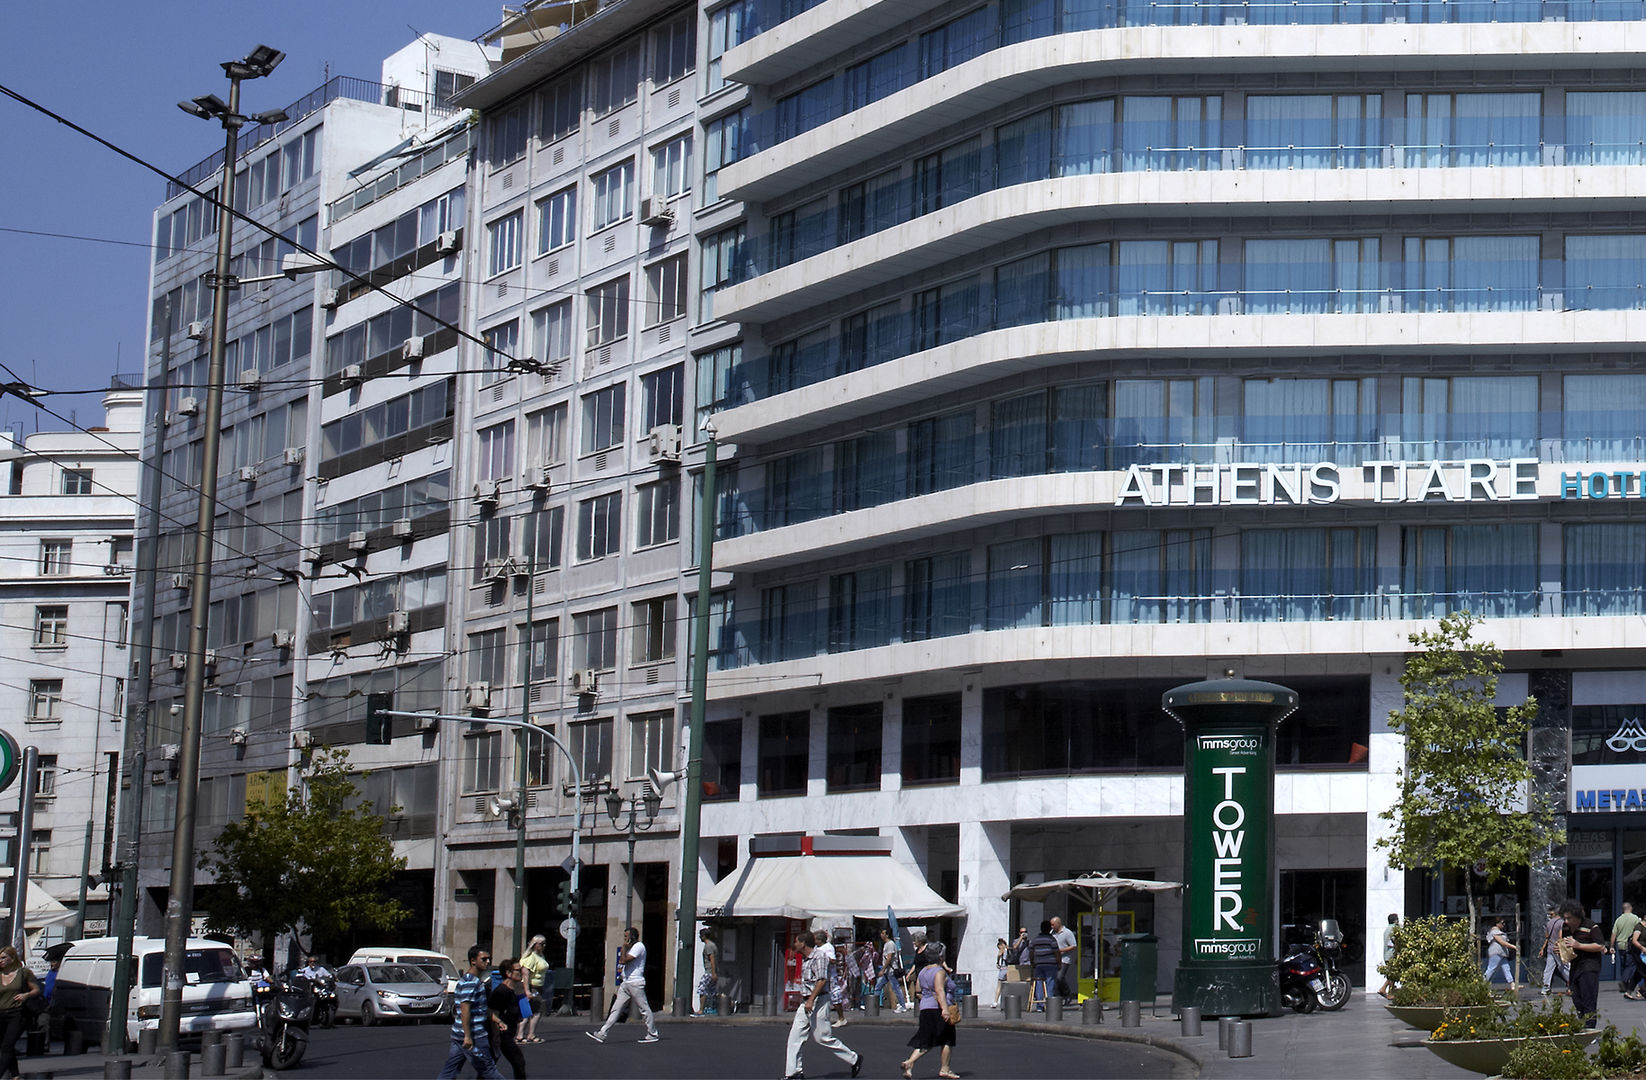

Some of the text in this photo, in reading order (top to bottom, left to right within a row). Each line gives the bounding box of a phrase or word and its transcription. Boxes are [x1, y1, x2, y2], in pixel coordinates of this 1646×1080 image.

[1115, 462, 1341, 507] ATHENS
[1362, 458, 1540, 503] TIARE
[1202, 739, 1258, 751] mmsgroup
[1212, 766, 1247, 932] TOWER
